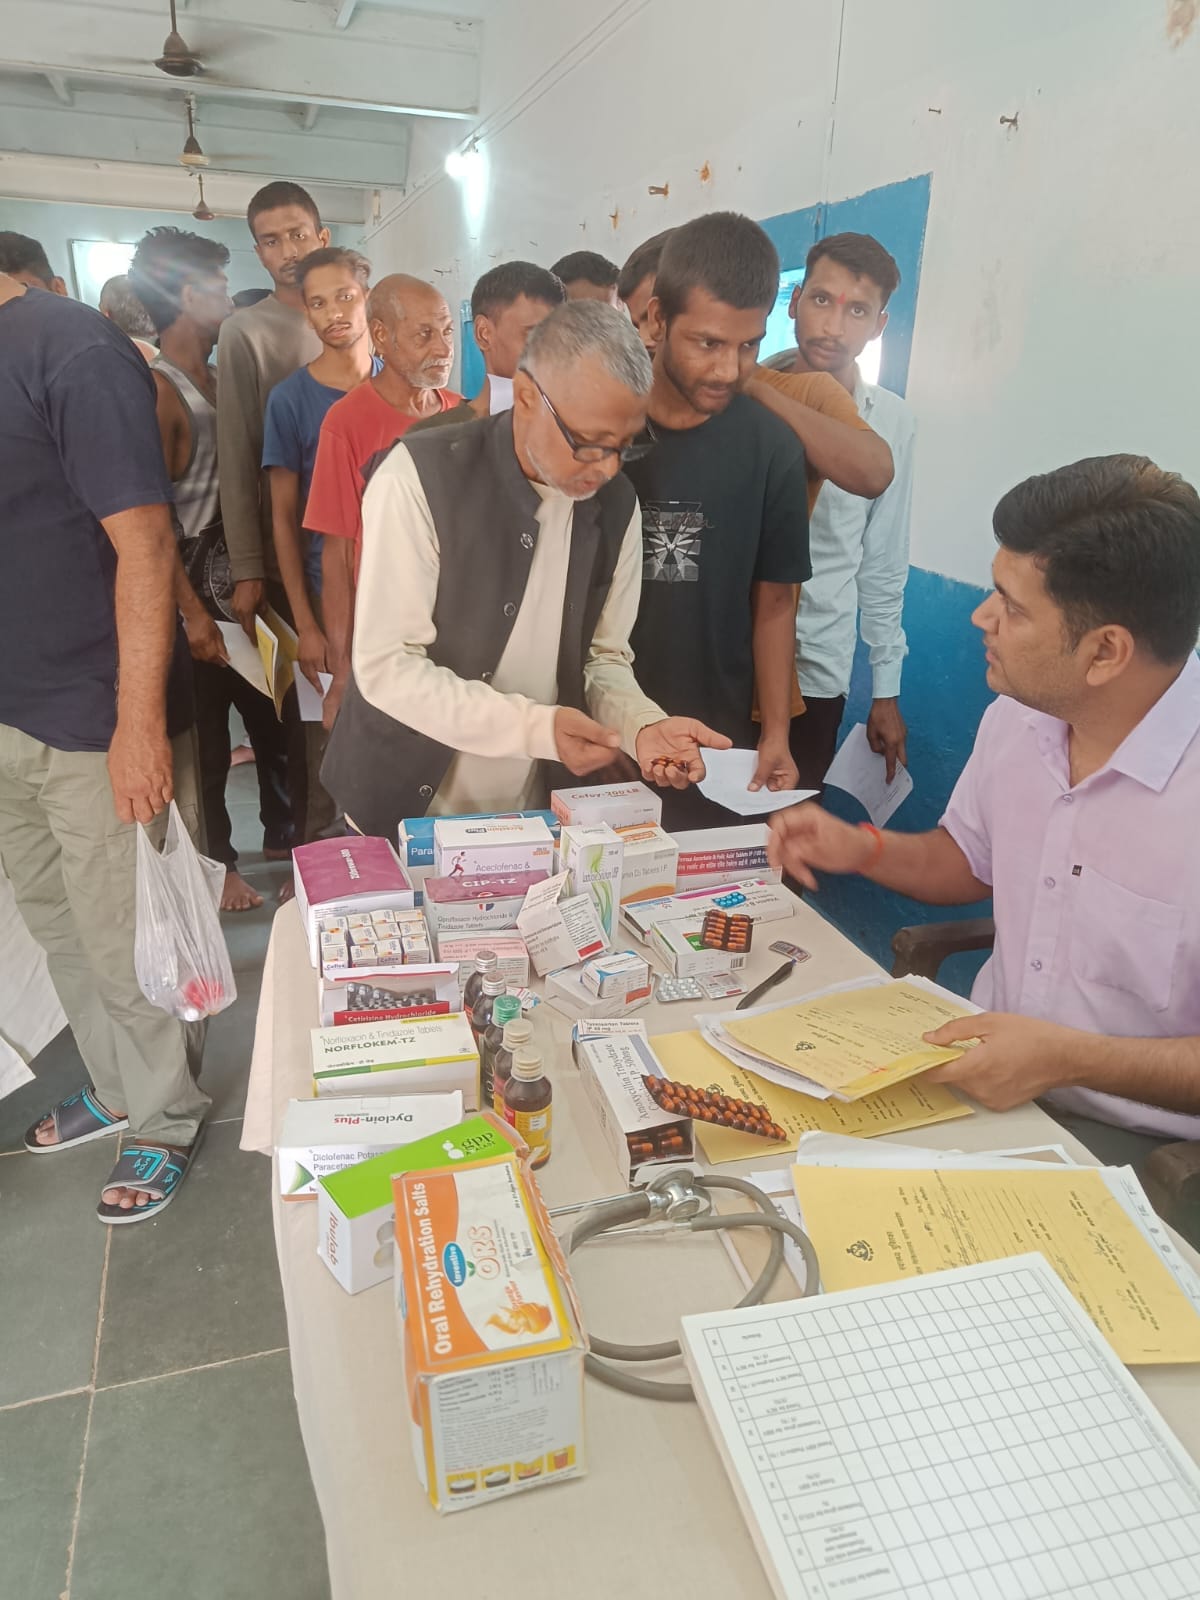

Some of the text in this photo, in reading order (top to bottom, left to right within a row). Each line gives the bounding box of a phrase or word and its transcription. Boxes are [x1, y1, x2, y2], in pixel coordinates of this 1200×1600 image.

[462, 878, 518, 887] CIP-TZ
[322, 1024, 443, 1045] Norfloxacin & Tinidazole Tablets
[313, 1153, 355, 1161] Diclofenac
[449, 1246, 461, 1283] Inventive
[468, 1226, 500, 1280] ORS
[412, 1182, 452, 1354] Oral Rehydration Salts
